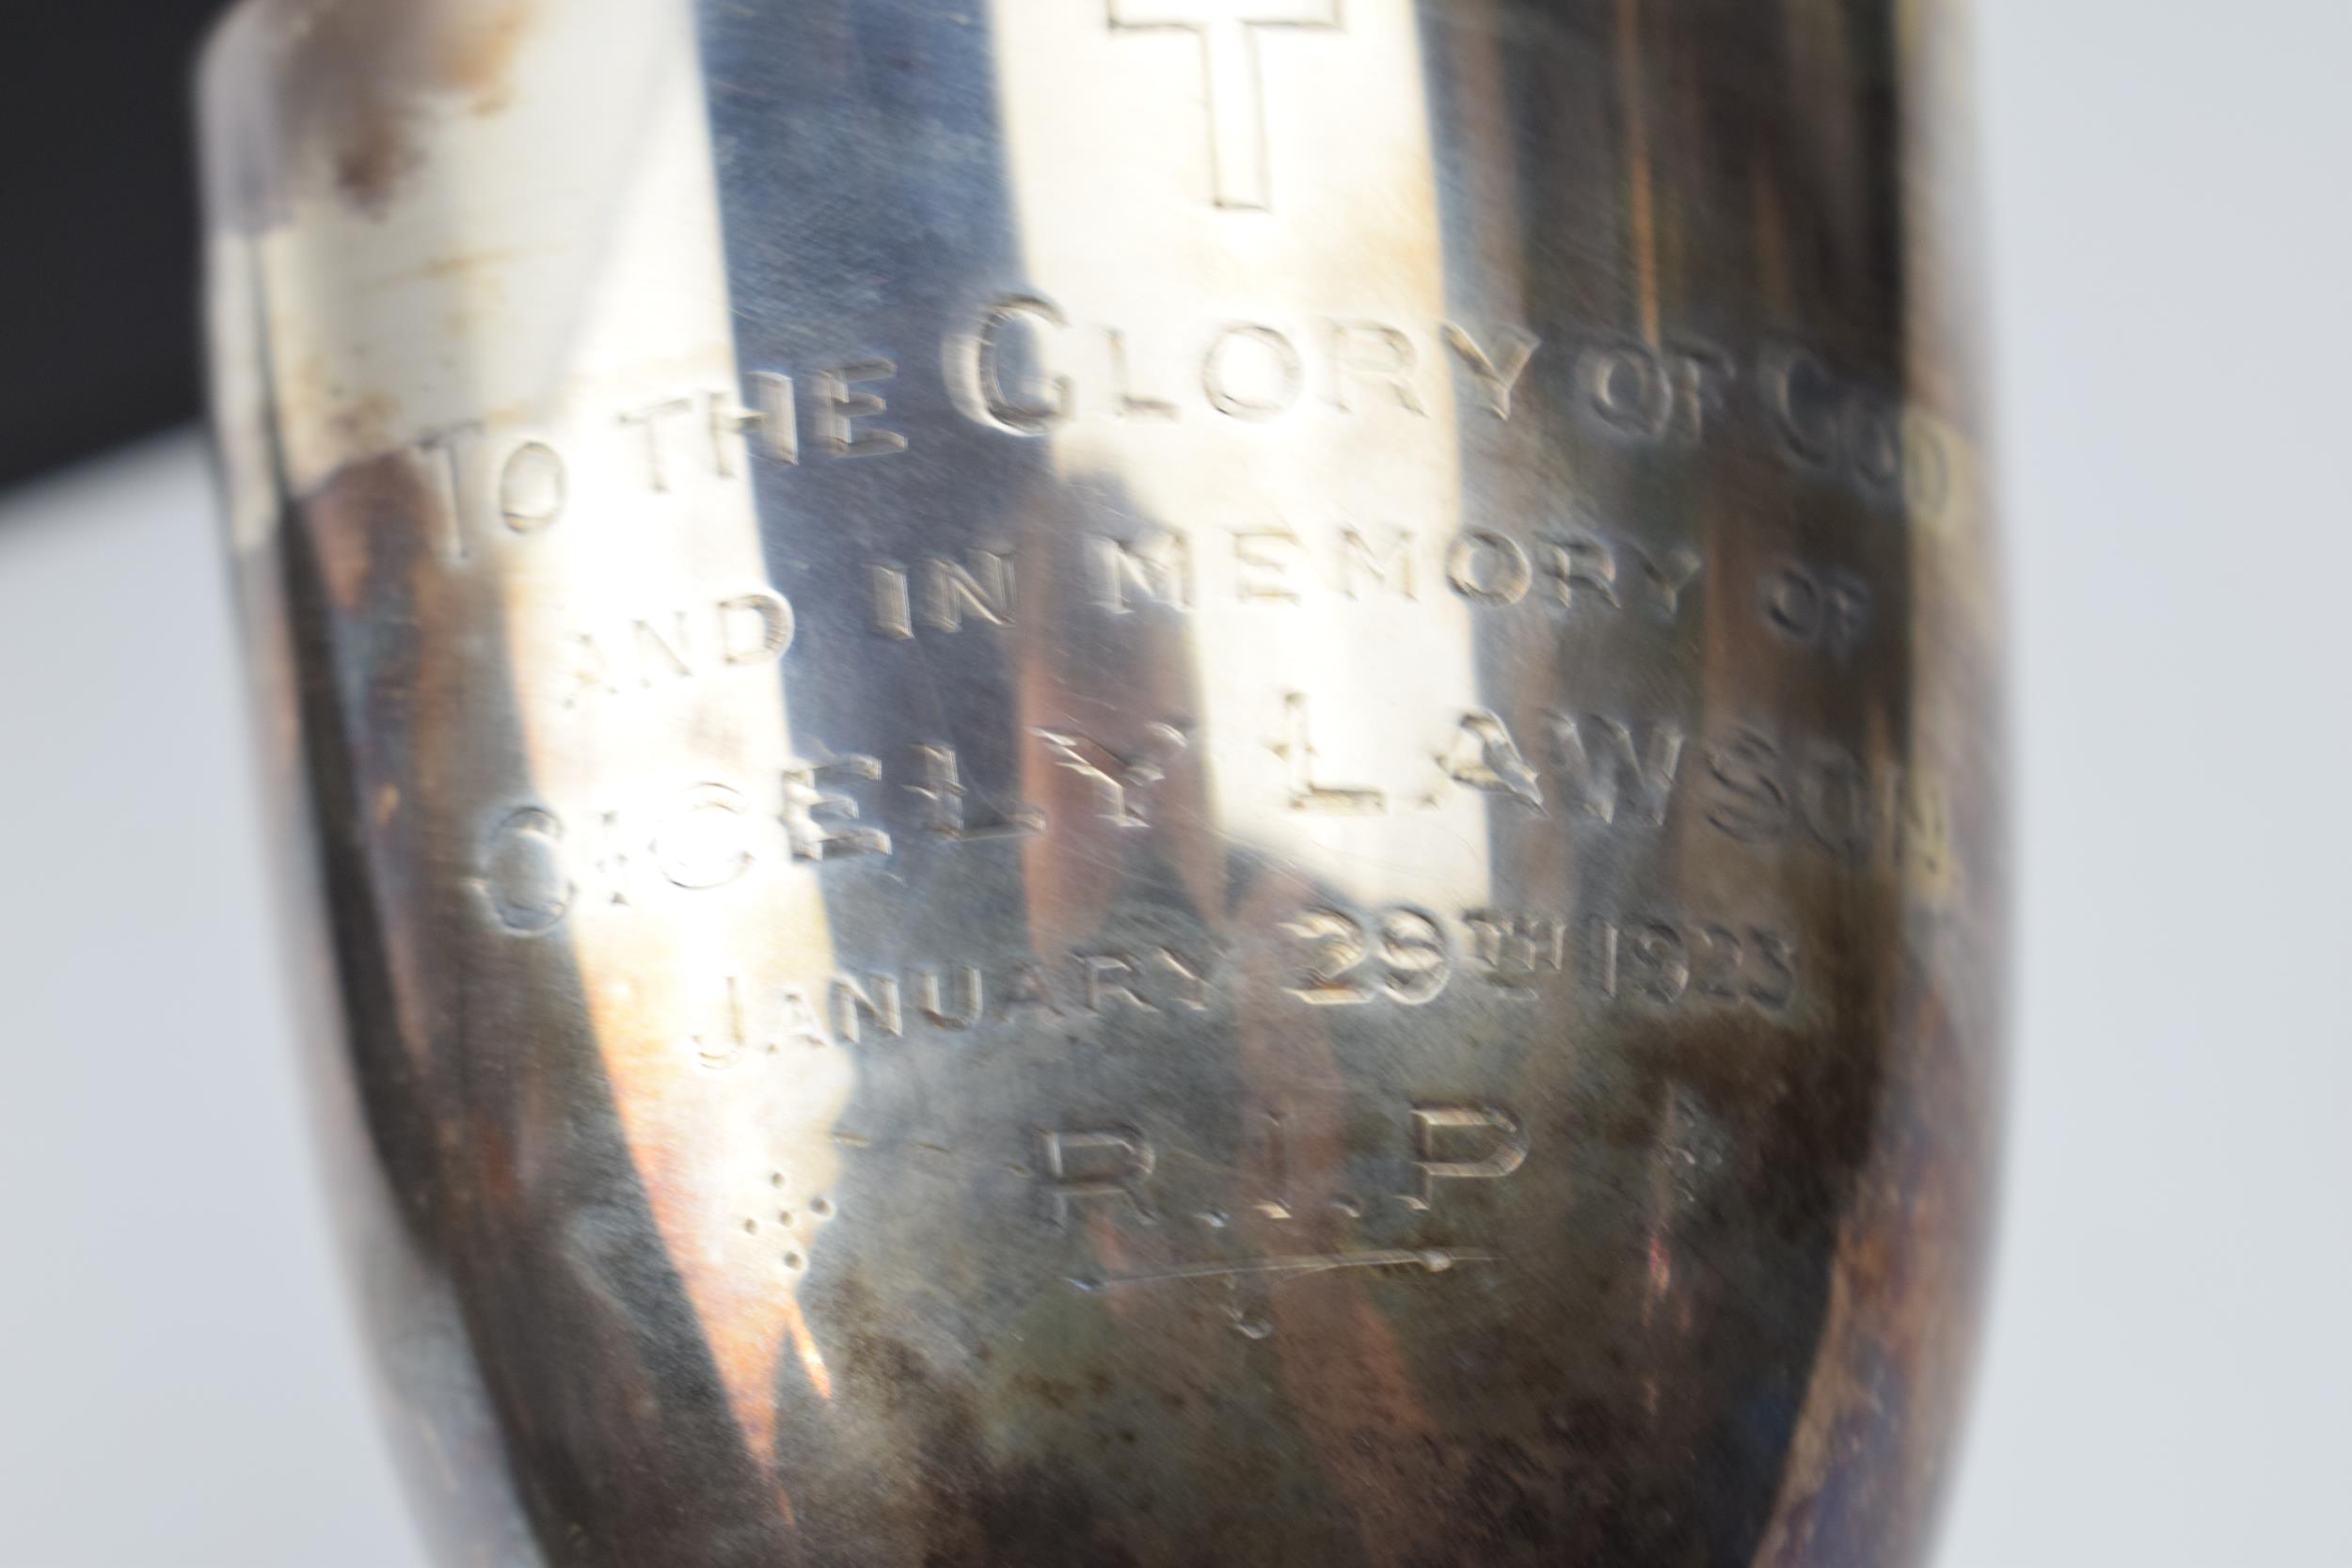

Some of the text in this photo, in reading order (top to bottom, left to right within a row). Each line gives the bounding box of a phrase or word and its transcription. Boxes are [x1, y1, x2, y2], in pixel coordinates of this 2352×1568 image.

[618, 354, 910, 493] THE
[946, 286, 1543, 436] GLORY
[1574, 327, 1737, 442] OF
[563, 523, 1872, 710] AND IN MEMORY OF
[690, 944, 1234, 1070] JANUARY
